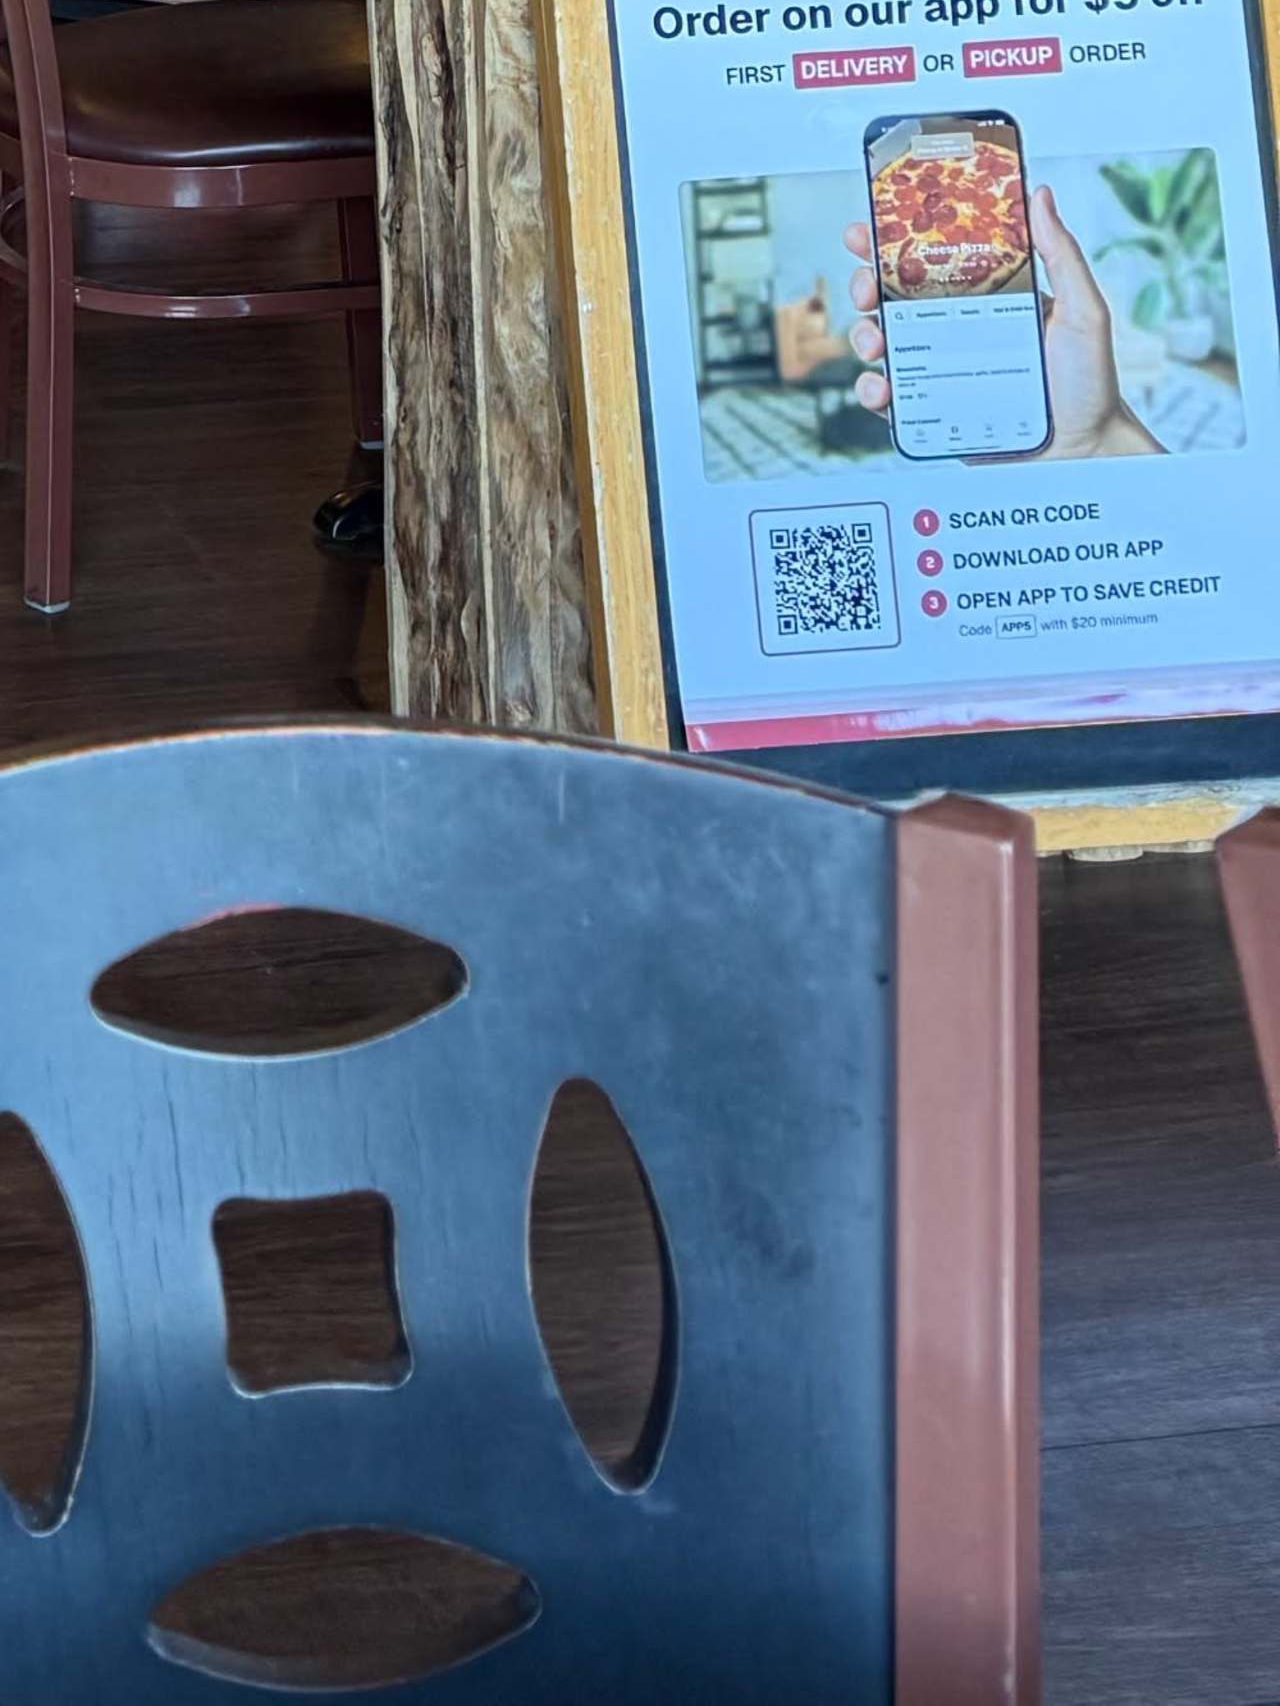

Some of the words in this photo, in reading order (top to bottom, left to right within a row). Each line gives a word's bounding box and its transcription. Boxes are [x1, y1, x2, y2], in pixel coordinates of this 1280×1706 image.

[653, 4, 770, 38] Order
[782, 4, 832, 30] on
[845, 0, 912, 27] our
[726, 64, 786, 85] FIRST
[800, 54, 908, 79] DELIVERY
[923, 54, 954, 72] OR
[969, 46, 1053, 69] PICKUP
[1070, 43, 1146, 63] ORDER
[960, 242, 990, 254] Pizza
[949, 510, 1005, 529] SCAN
[1011, 508, 1039, 525] QR
[1044, 503, 1100, 523] CODE
[925, 556, 935, 570] 2
[953, 545, 1070, 569] DOWNLOAD
[1075, 543, 1119, 561] OUR
[1125, 540, 1163, 558] APP
[929, 597, 939, 611] 3
[957, 592, 1011, 609] OPEN
[1017, 588, 1056, 606] APP
[1061, 585, 1088, 603] TO
[1093, 581, 1145, 600] SAVE
[1150, 576, 1221, 597] CREDIT
[959, 624, 992, 636] Code
[1041, 617, 1068, 631] with
[1071, 615, 1096, 629] $20
[1100, 613, 1158, 625] minimum
